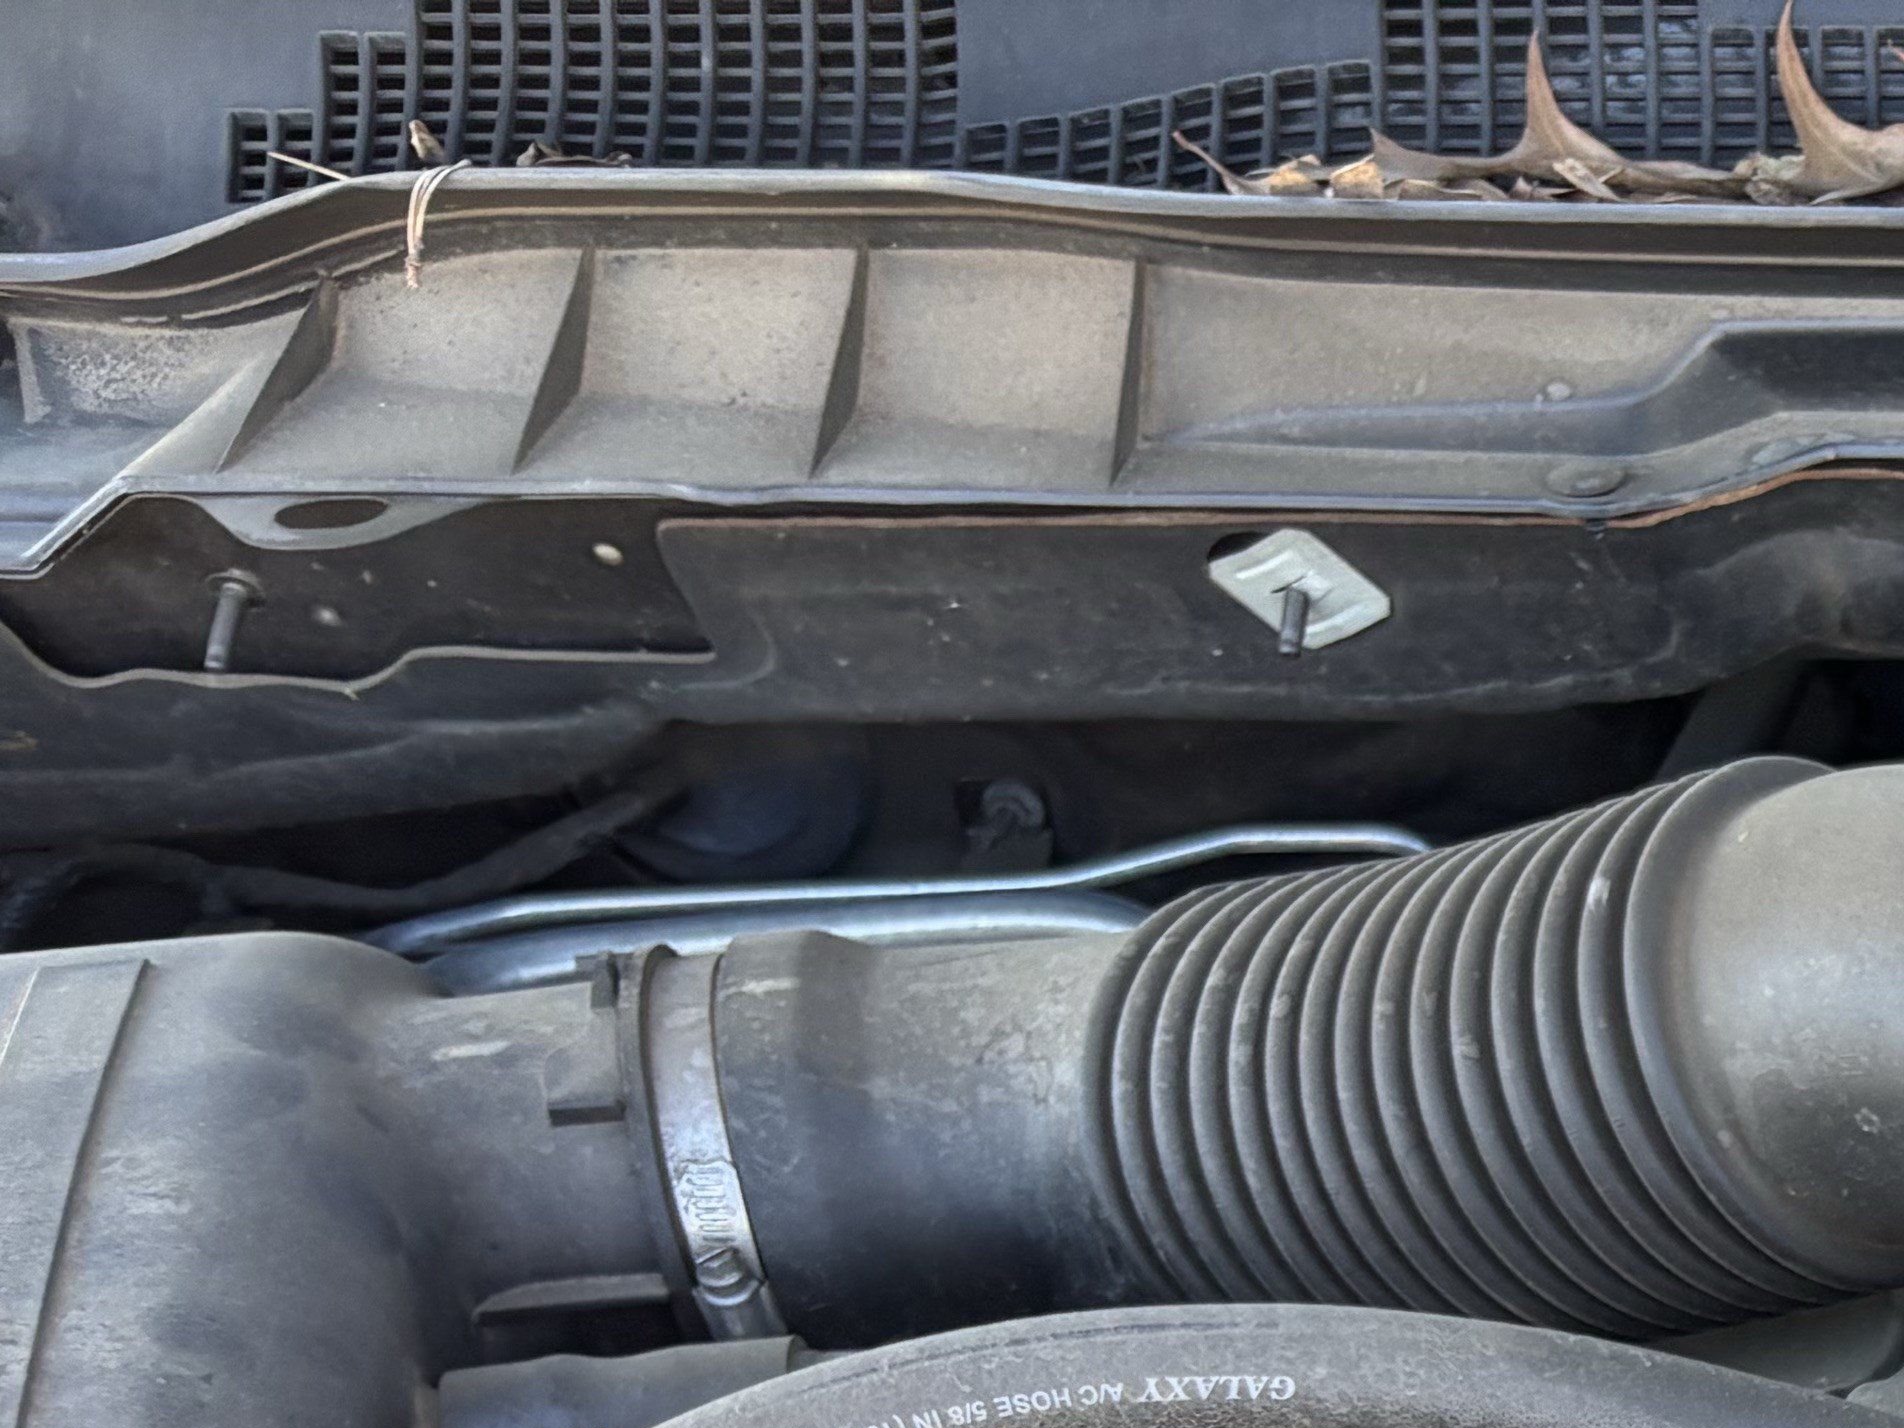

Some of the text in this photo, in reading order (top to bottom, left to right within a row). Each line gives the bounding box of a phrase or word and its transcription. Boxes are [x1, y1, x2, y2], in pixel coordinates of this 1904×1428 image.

[1076, 1381, 1125, 1406] A/C
[1137, 1375, 1297, 1403] GALAXY
[947, 1402, 989, 1427] 5/8
[997, 1386, 1070, 1420] HOSE
